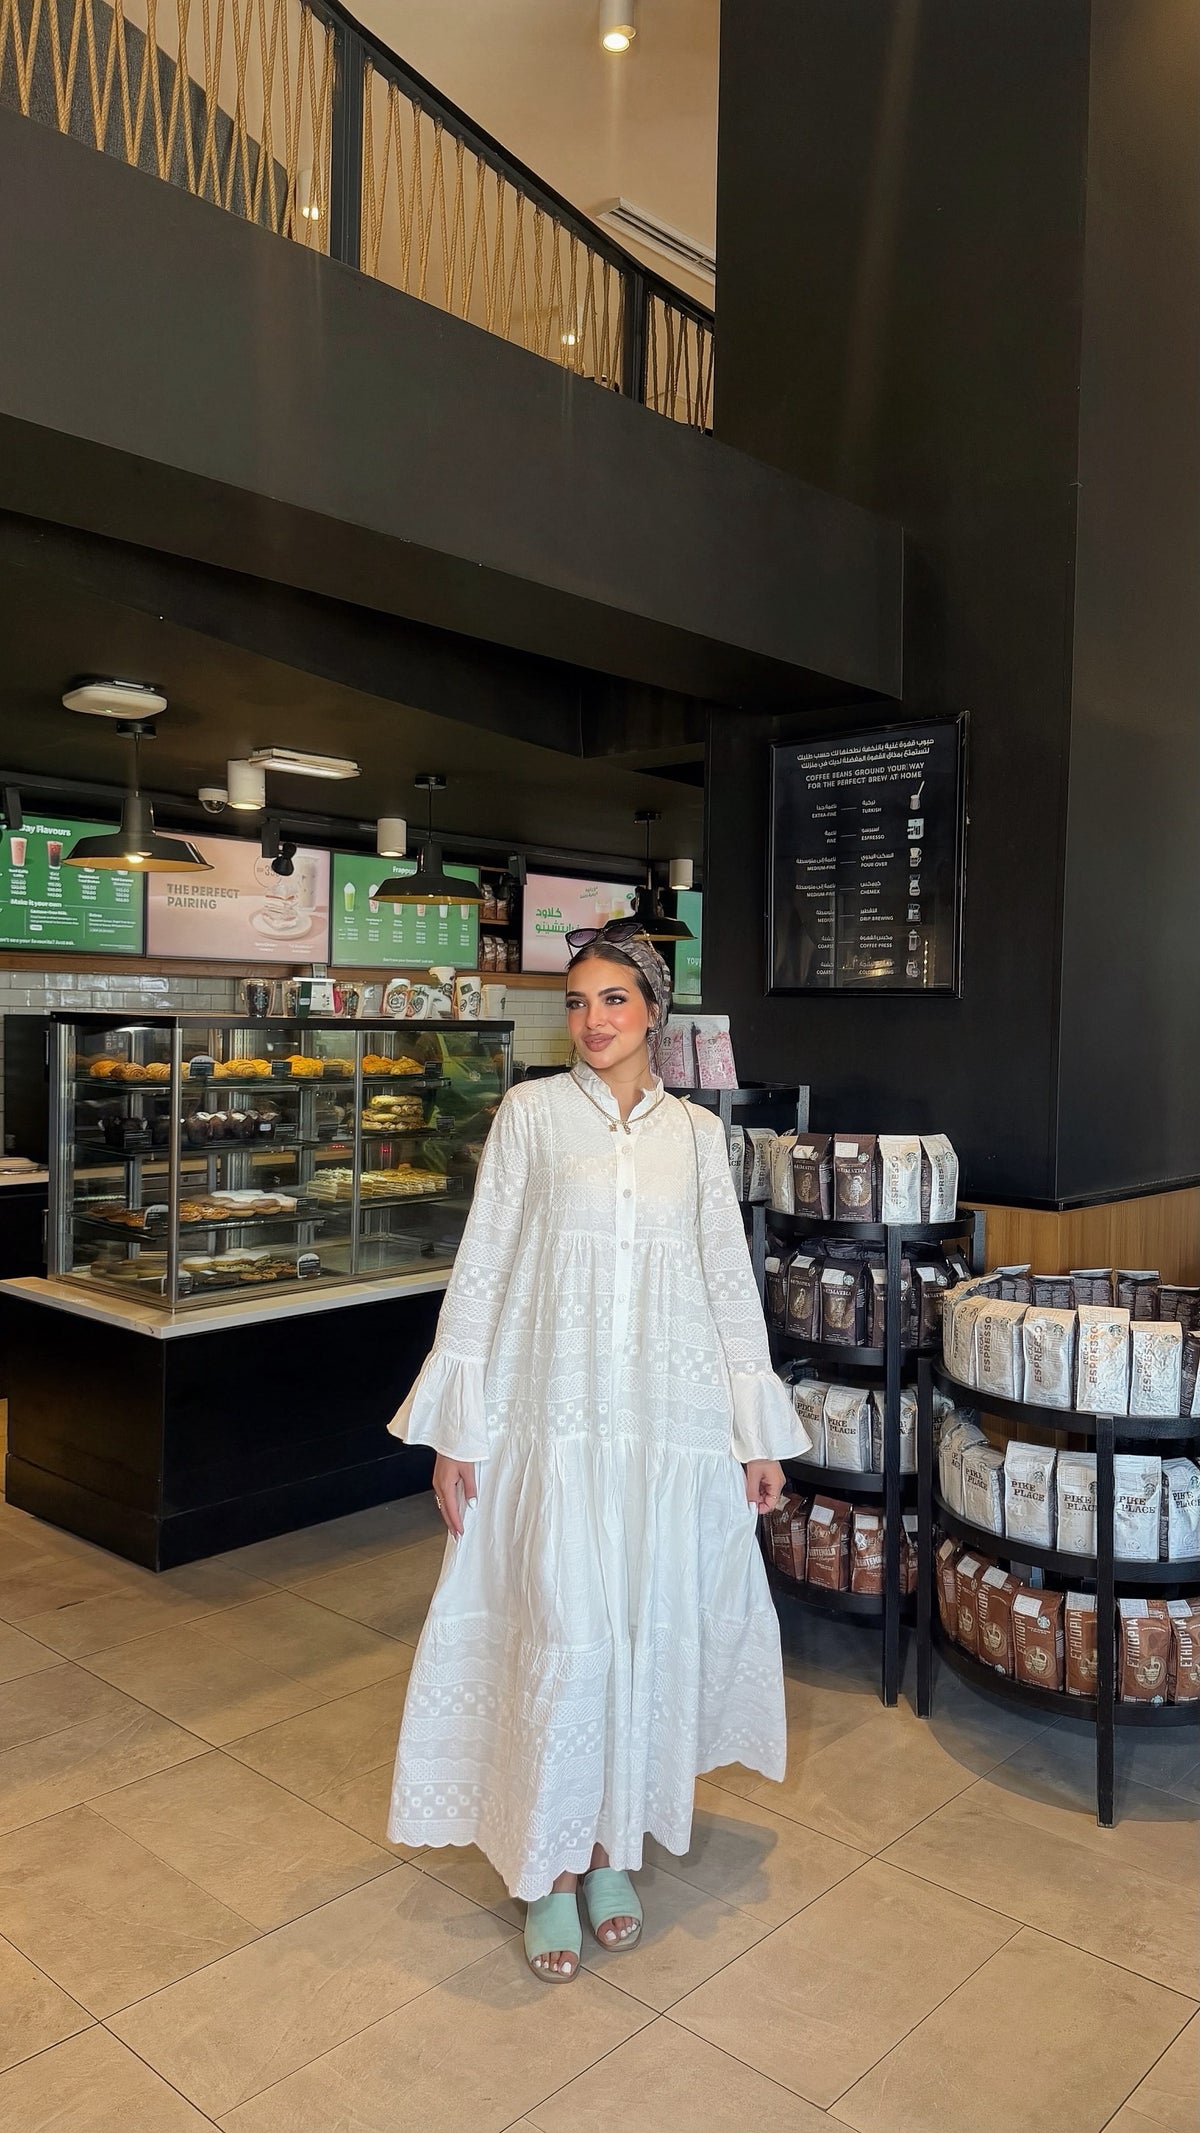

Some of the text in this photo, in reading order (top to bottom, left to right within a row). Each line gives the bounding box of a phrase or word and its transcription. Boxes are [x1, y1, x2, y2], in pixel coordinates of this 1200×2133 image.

[899, 739, 916, 749] قهوة
[805, 762, 925, 782] COFFEE BEANS GROUND YOUR WAY
[807, 770, 922, 790] FOR THE PERFECT BREW AT HOME
[36, 824, 72, 837] Flavours
[166, 883, 240, 899] THE PERFECT
[167, 896, 217, 910] PAIRING
[535, 907, 562, 919] كلاود
[891, 1155, 899, 1205] ESPRESSO
[935, 1155, 945, 1205] ESPRESSO
[984, 1316, 992, 1373] ESPRESSO
[1034, 1325, 1043, 1383] ESPRESSO
[1089, 1326, 1099, 1384] ESPRESSO
[797, 1402, 815, 1413] PIKE
[798, 1410, 820, 1421] PLACE
[828, 1417, 848, 1428] PIKE
[829, 1425, 857, 1435] PLACE
[965, 1467, 983, 1481] PIKE
[967, 1475, 988, 1491] PLACE
[1011, 1480, 1036, 1492] PIKE
[1013, 1489, 1045, 1502] PLACE
[1063, 1494, 1092, 1504] PIKE
[1119, 1495, 1147, 1506] PIKE
[1172, 1491, 1194, 1501] PIKE
[1066, 1503, 1098, 1512] PLAC
[1121, 1504, 1156, 1514] PLACE
[978, 1583, 992, 1630] ETHIOPIA
[1015, 1613, 1027, 1655] ETHIOPI
[1070, 1611, 1082, 1660] ETHIOPIA
[1126, 1618, 1140, 1668] ETHIOPIA
[1174, 1618, 1193, 1667] ETHIOPIA
